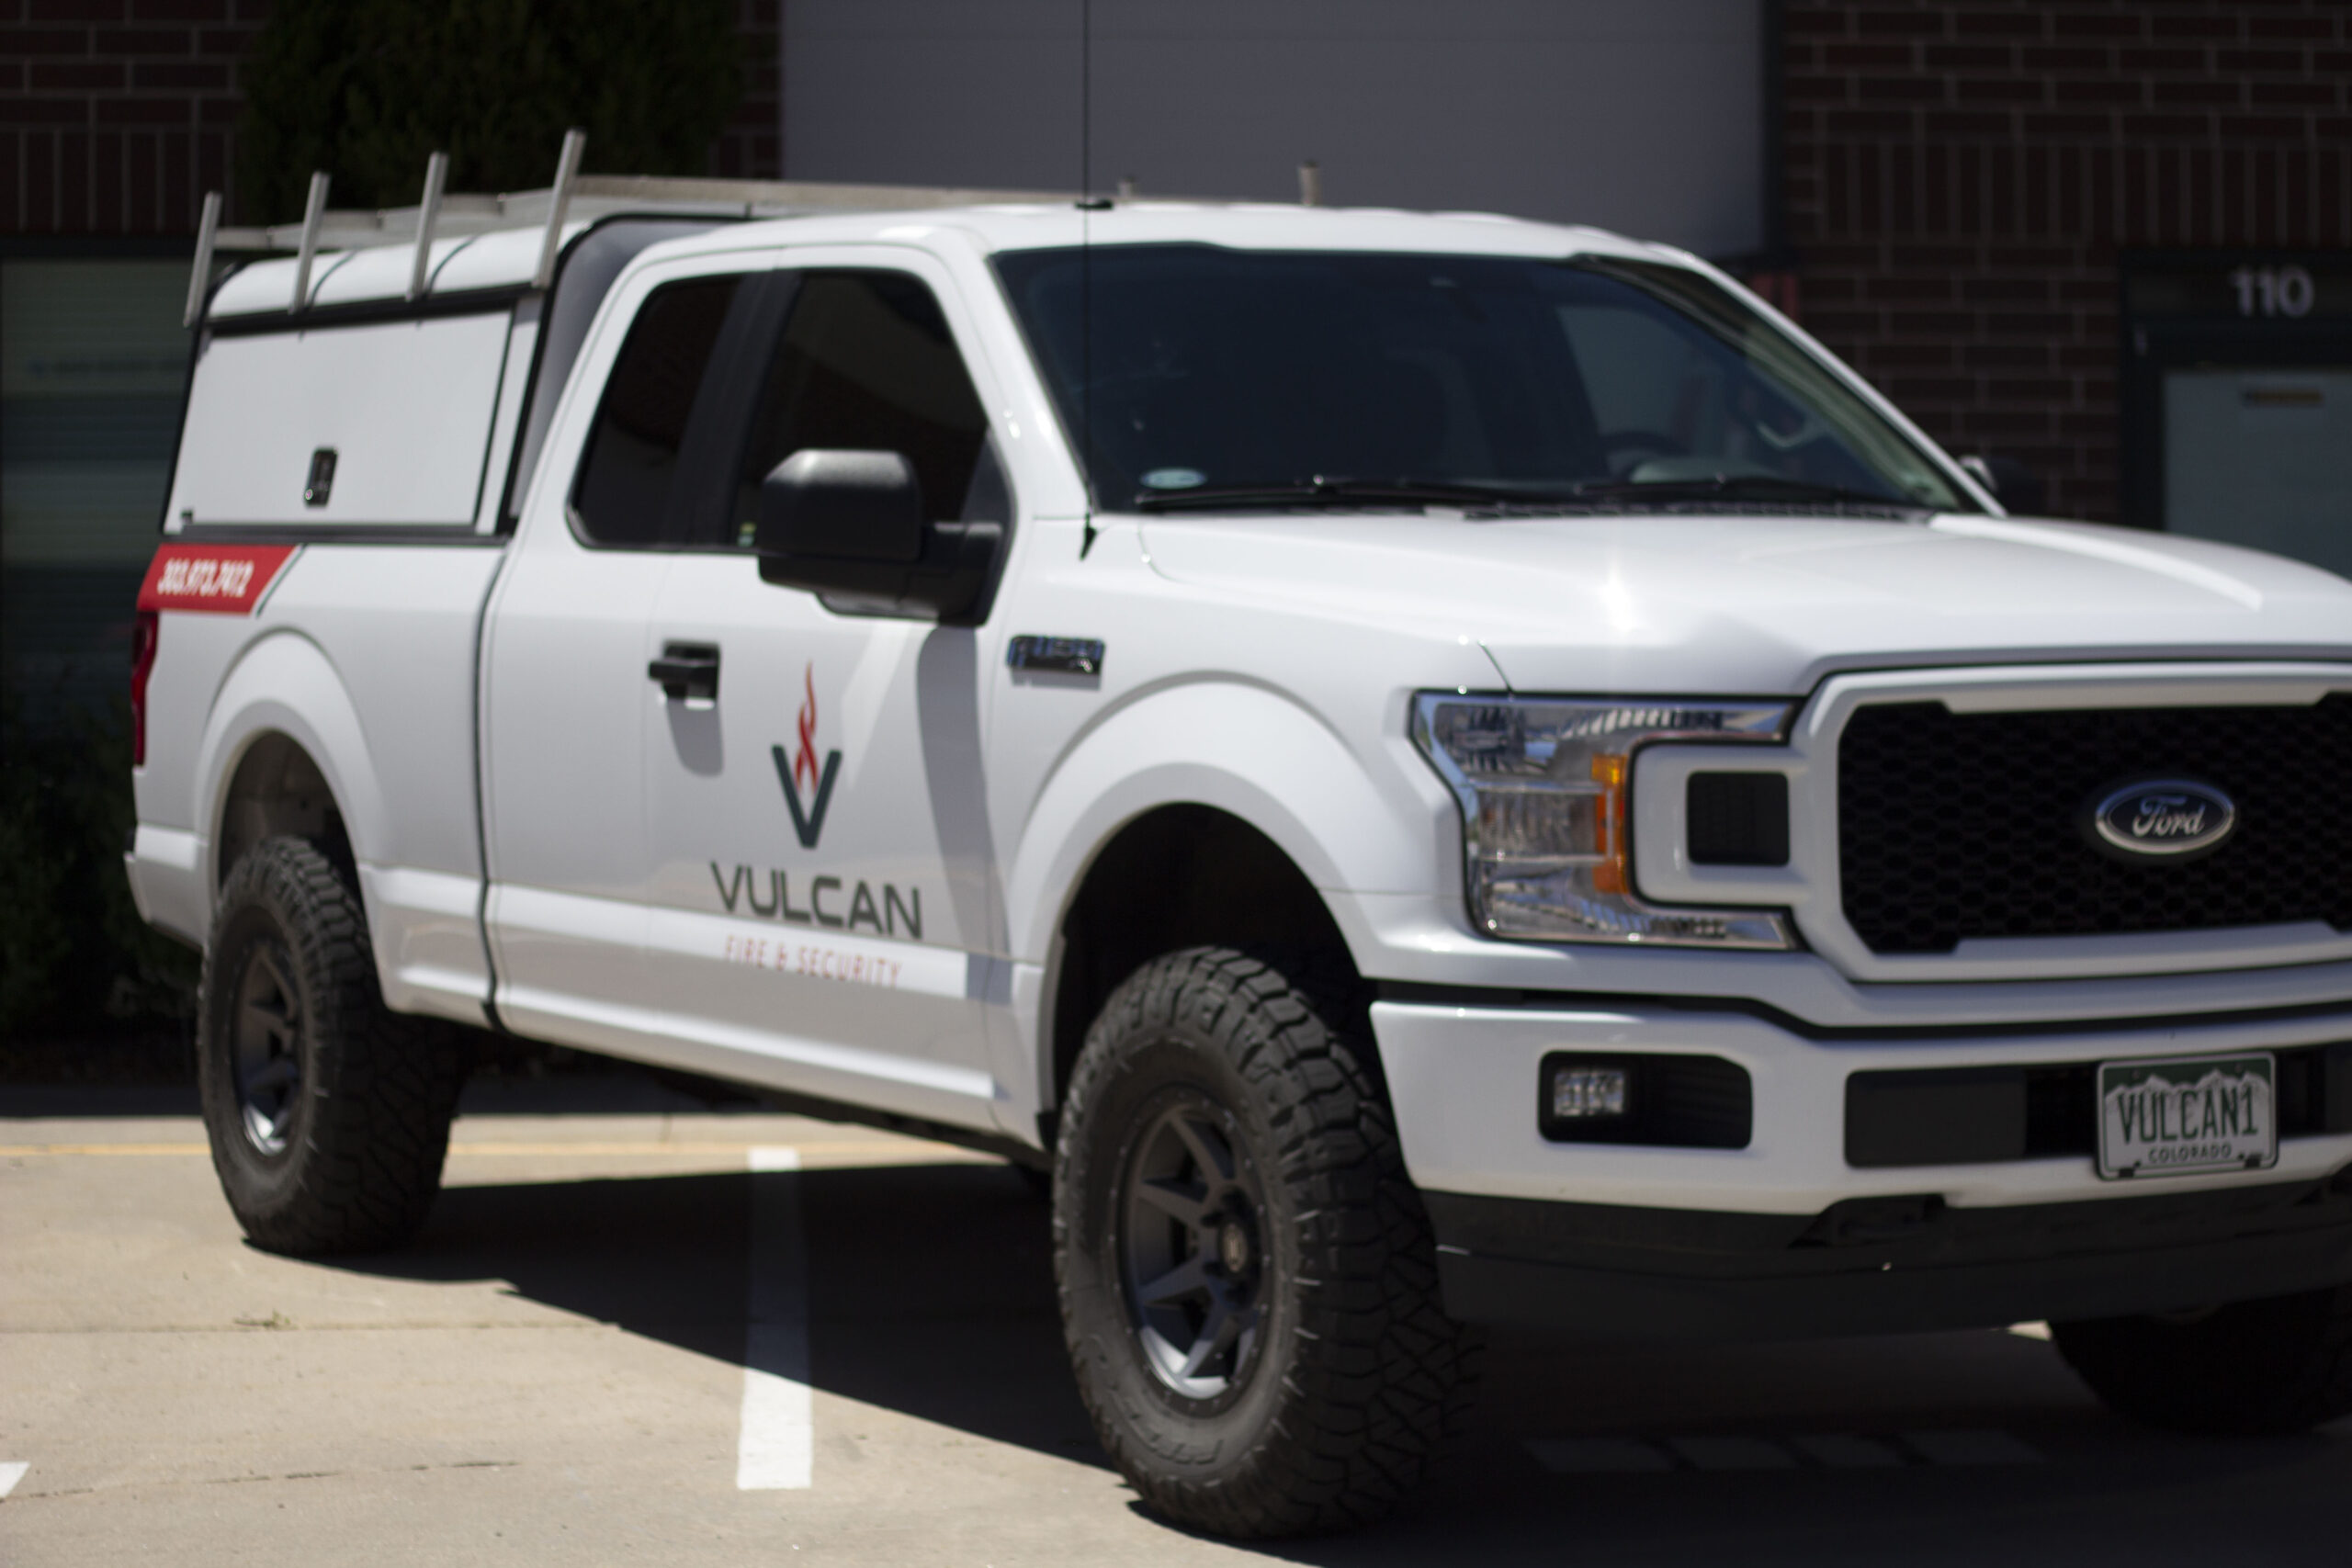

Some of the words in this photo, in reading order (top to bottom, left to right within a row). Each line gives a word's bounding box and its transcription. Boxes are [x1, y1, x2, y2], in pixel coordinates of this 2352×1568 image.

[2229, 266, 2315, 318] 110
[2132, 795, 2206, 837] Ford
[709, 861, 922, 940] VULCAN
[725, 934, 766, 970] FIRE
[797, 945, 904, 989] SECURITY
[2118, 1086, 2258, 1145] VULCAN1
[2148, 1143, 2233, 1164] COLORADO
